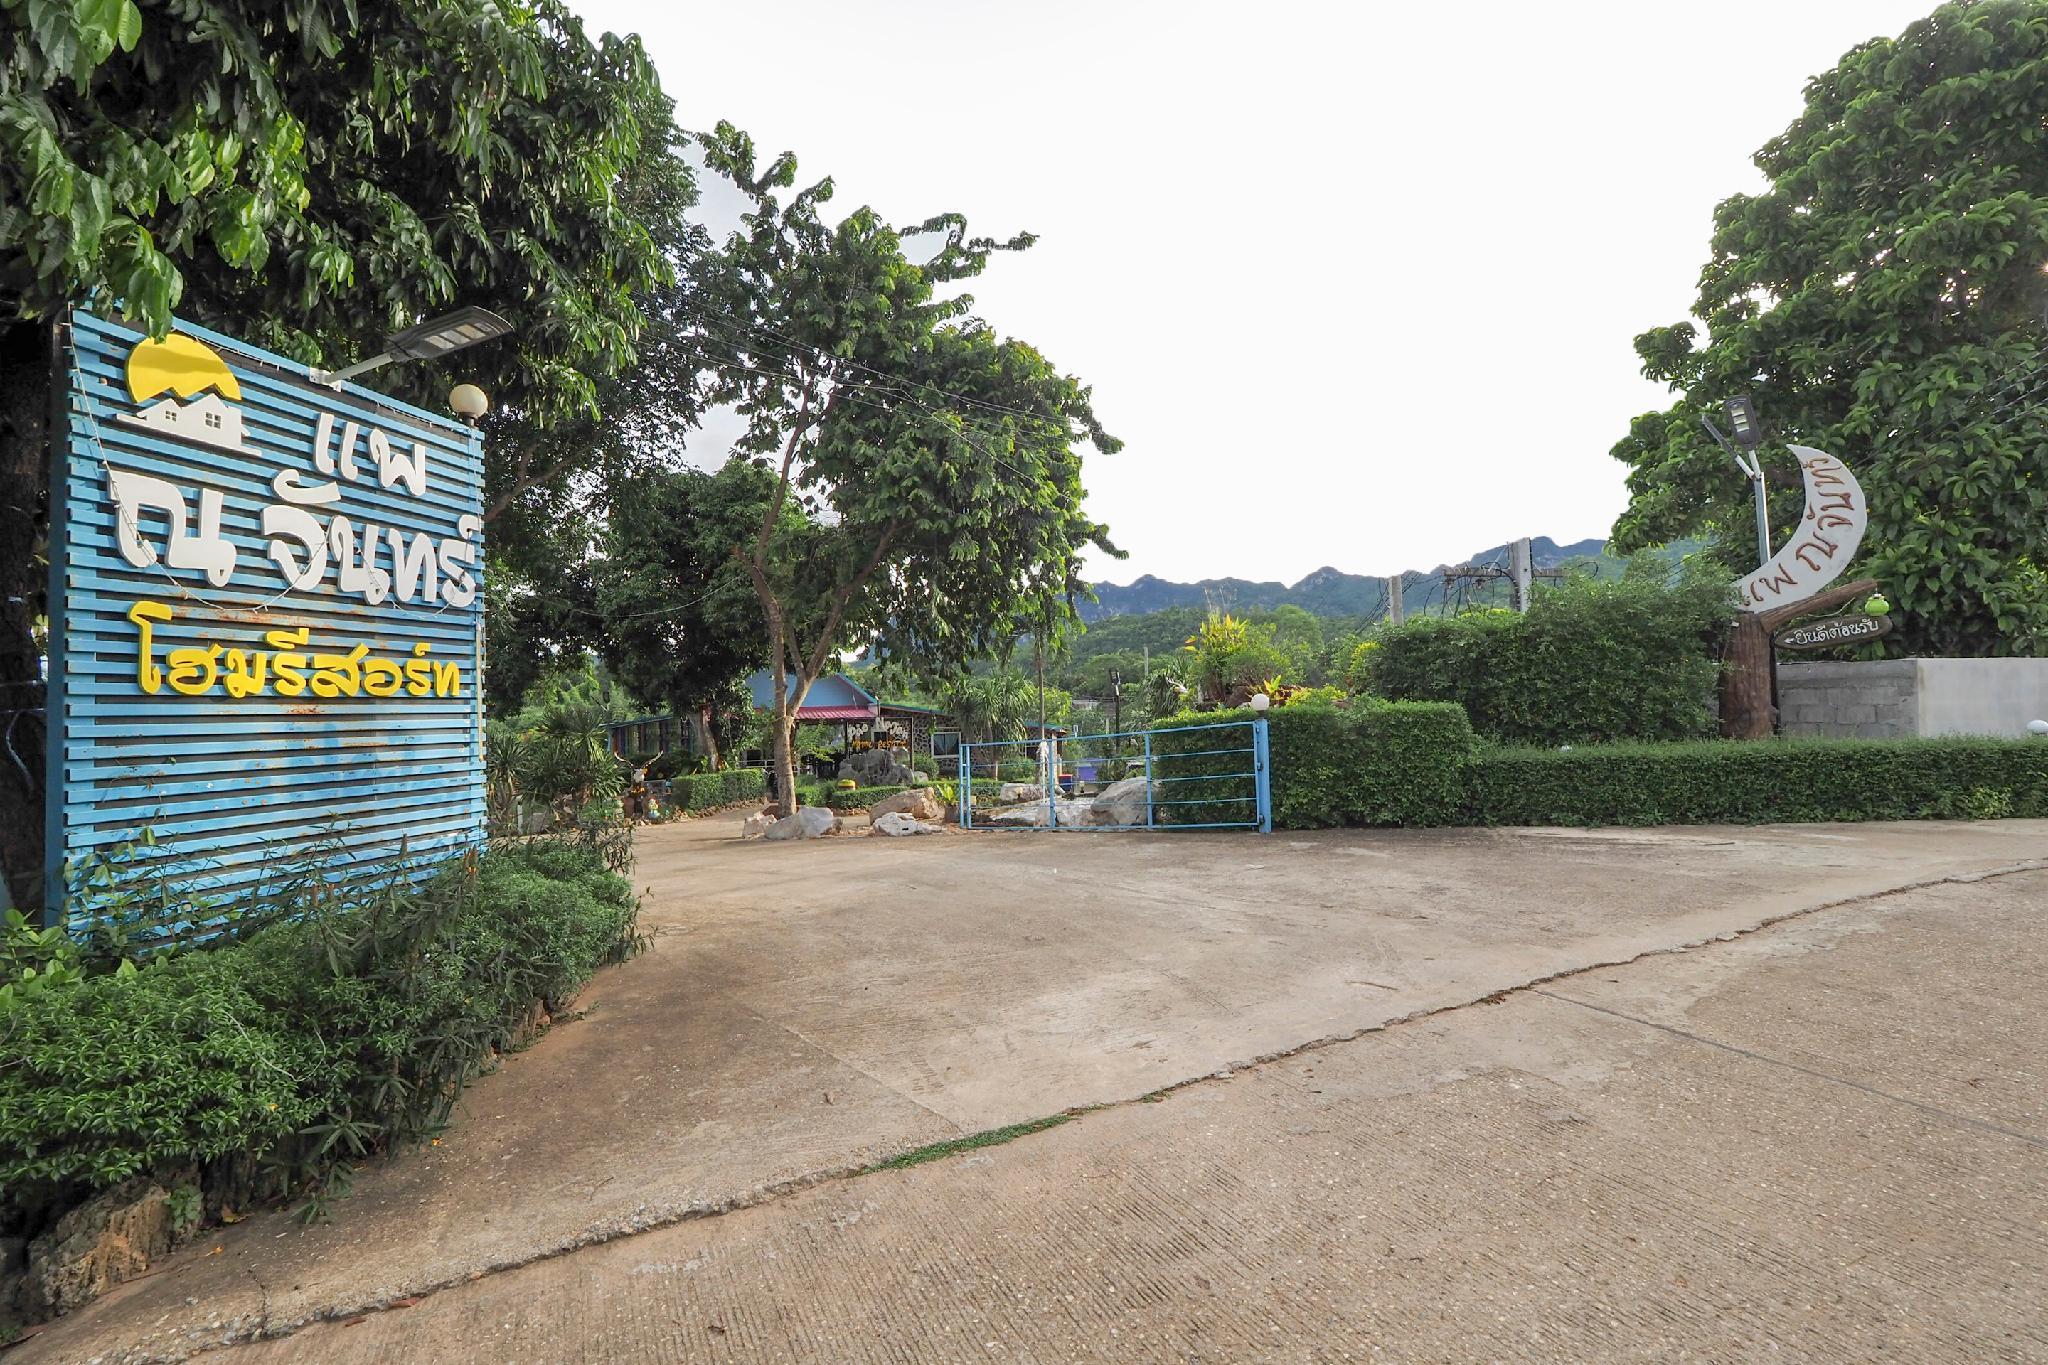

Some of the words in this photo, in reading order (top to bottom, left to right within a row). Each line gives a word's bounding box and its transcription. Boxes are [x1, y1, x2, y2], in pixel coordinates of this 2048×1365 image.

[313, 412, 426, 496] แพ
[108, 469, 237, 588] ณ
[260, 468, 481, 608] จันทร์
[127, 600, 460, 699] โฮมรีสอร์ท
[1793, 618, 1879, 644] ยินดีต้อนรับ
